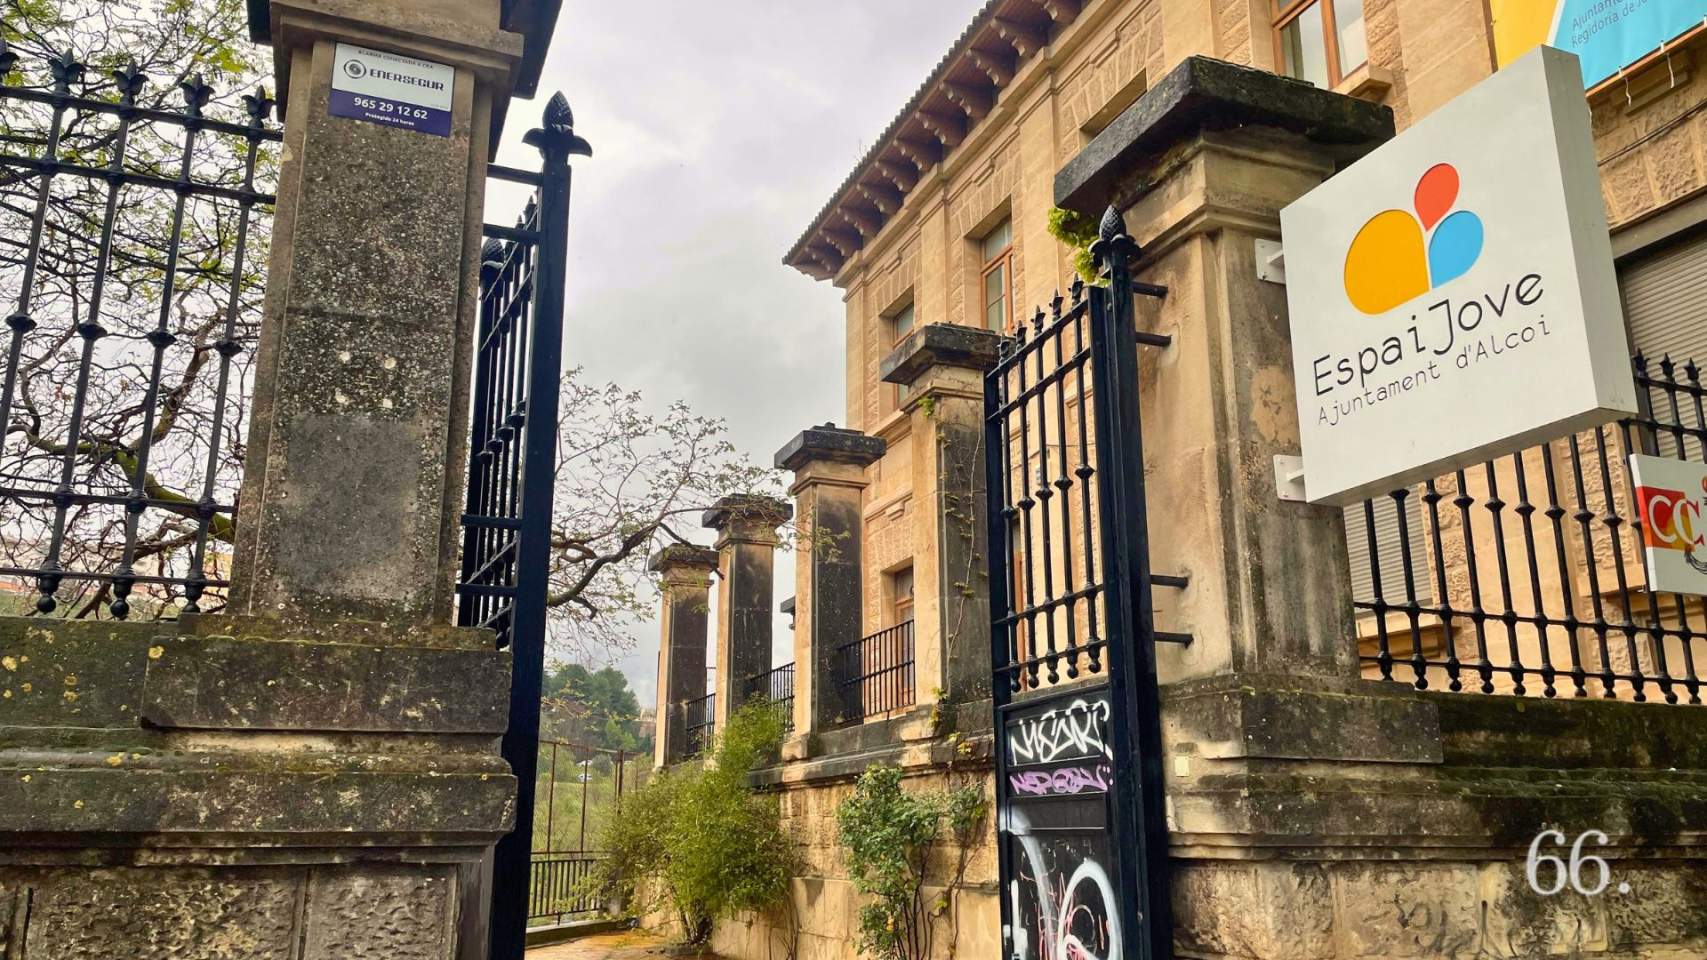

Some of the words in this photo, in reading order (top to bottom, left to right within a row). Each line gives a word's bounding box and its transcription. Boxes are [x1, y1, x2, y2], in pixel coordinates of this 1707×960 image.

[1572, 0, 1622, 31] Ajuntam
[1622, 3, 1635, 17] de
[369, 68, 444, 91] ENERSEGUR
[354, 97, 376, 109] 965
[379, 101, 394, 112] 29
[397, 105, 410, 116] 12
[413, 109, 428, 120] 62
[1319, 361, 1441, 426] Ajuntament
